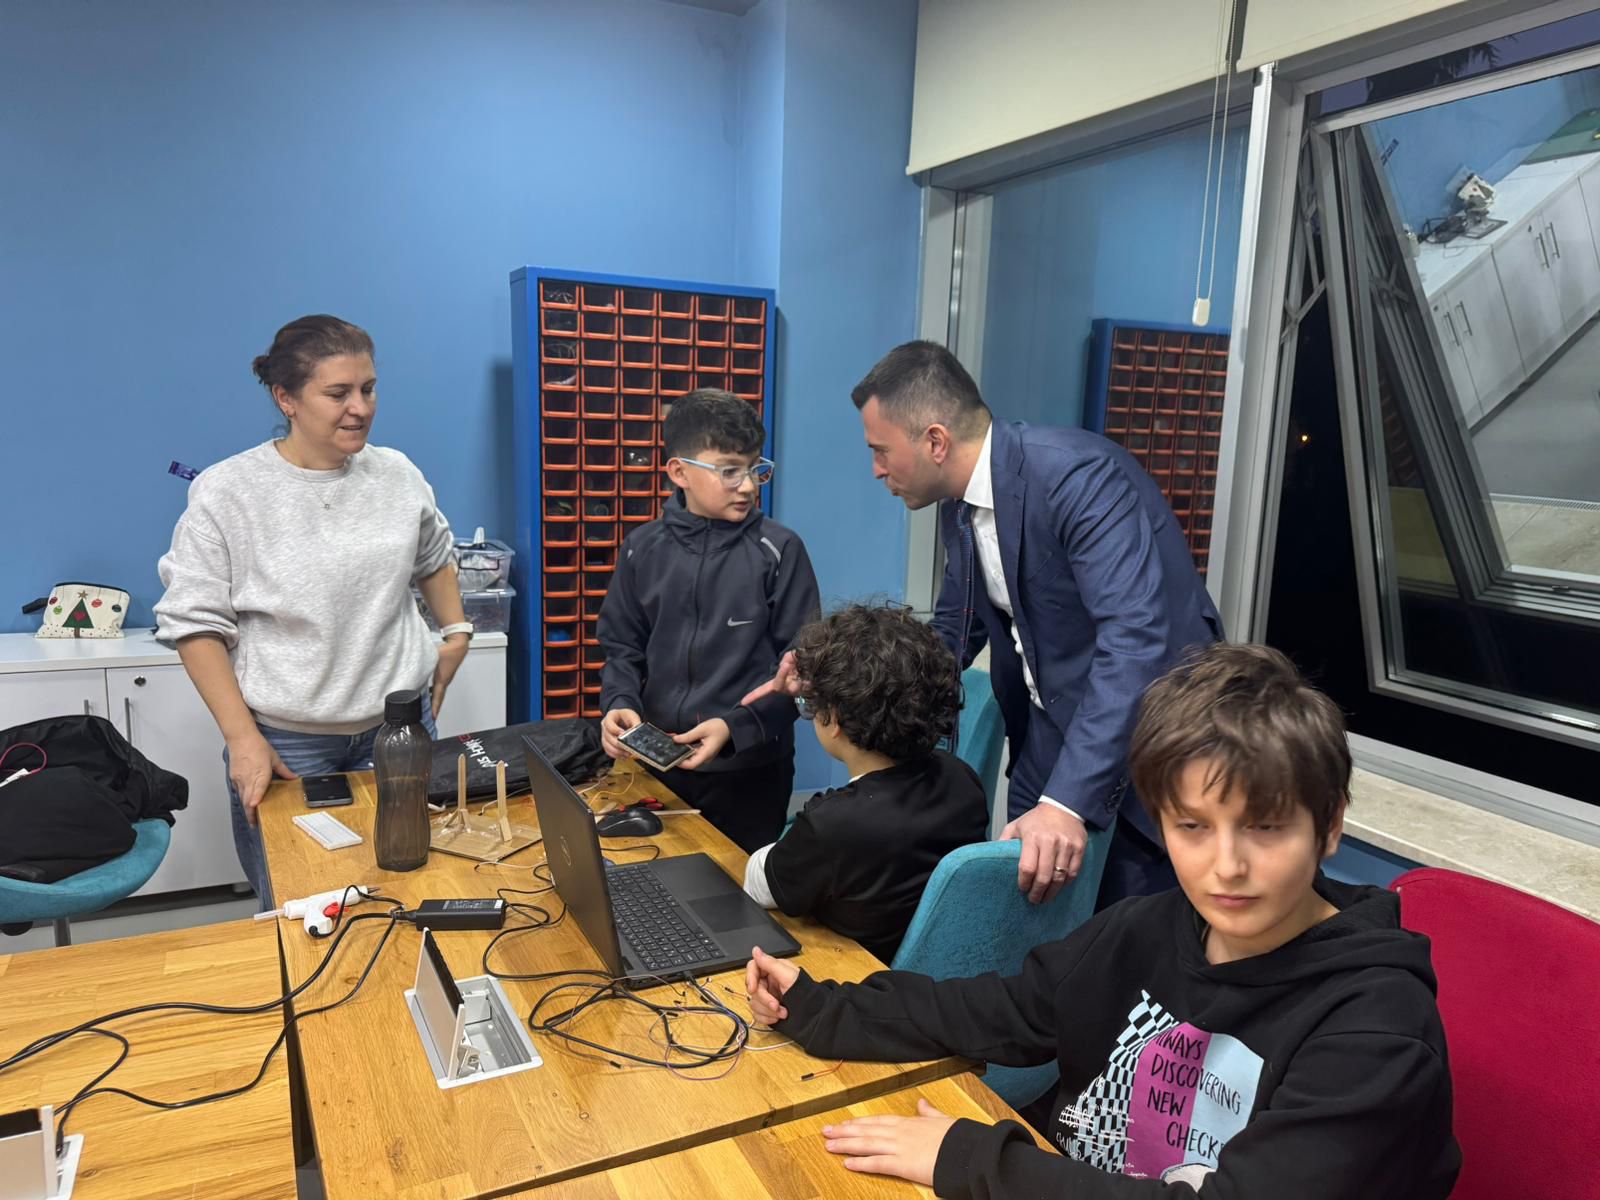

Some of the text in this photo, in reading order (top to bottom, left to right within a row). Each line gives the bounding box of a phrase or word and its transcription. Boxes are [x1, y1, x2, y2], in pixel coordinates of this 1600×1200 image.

[1147, 1086, 1187, 1117] NEW
[1151, 1053, 1241, 1115] DISCOVERING
[1166, 1122, 1225, 1161] CHECK
